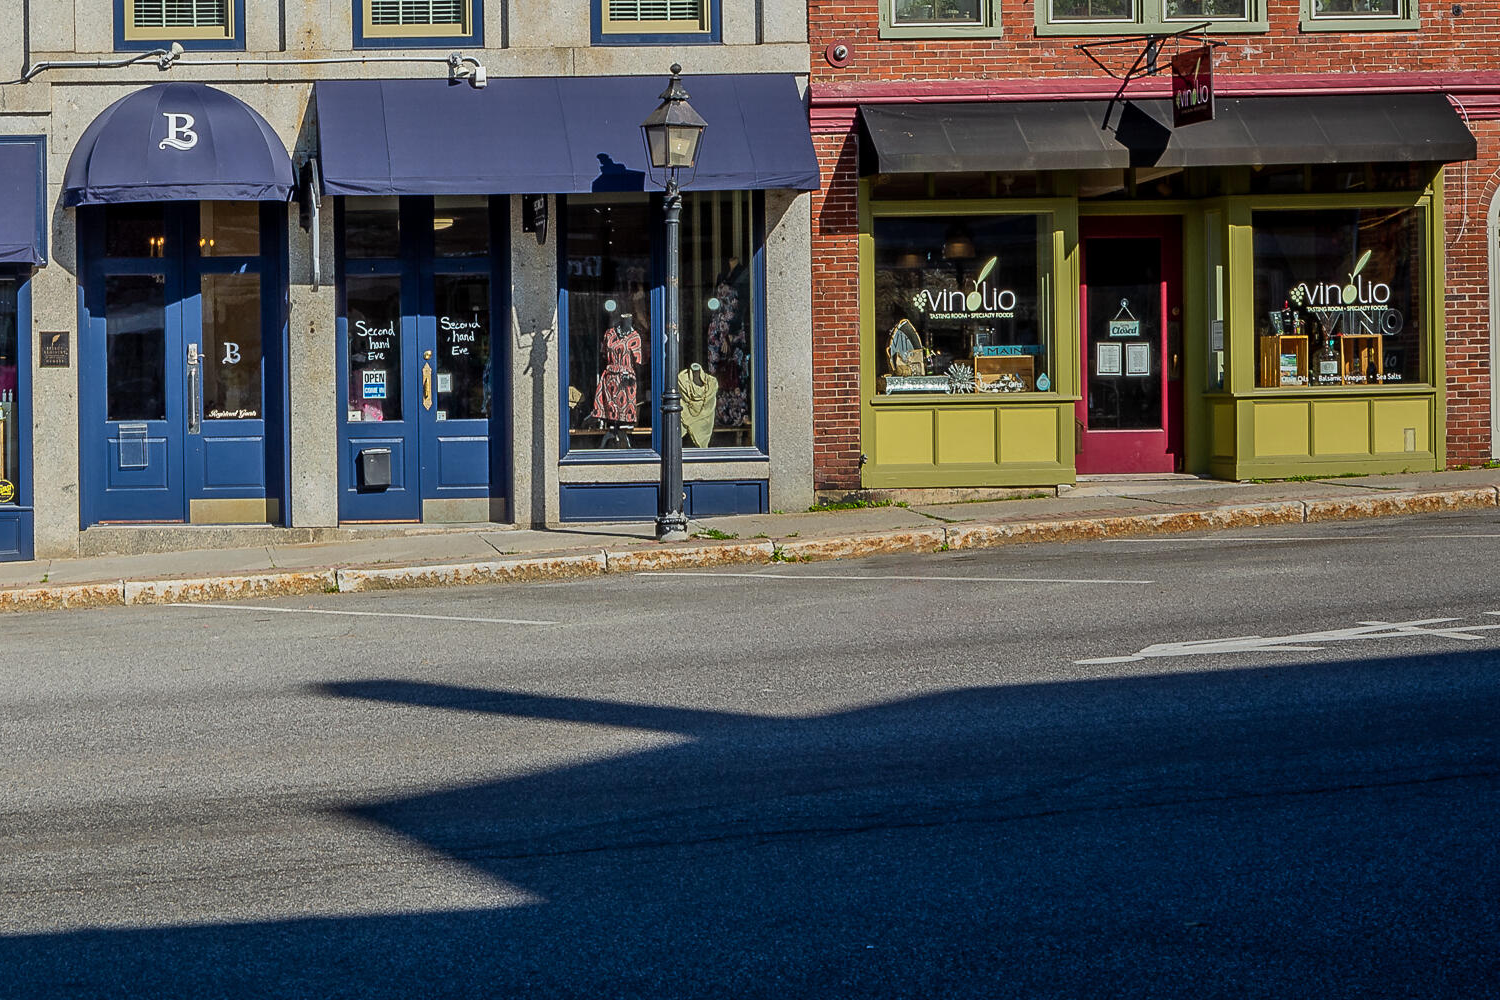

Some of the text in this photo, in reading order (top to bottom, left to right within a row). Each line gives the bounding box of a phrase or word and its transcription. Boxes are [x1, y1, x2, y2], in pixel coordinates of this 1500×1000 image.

[158, 112, 198, 150] B
[920, 281, 1016, 312] vinolio
[1298, 274, 1391, 305] vinolio
[355, 320, 396, 337] Second
[440, 313, 481, 330] Second
[452, 330, 475, 343] hand
[1111, 326, 1138, 335] Closed
[368, 336, 391, 350] hand
[222, 342, 241, 365] B
[367, 351, 386, 361] Eve
[451, 345, 470, 356] Eve
[364, 373, 385, 383] OPEN
[1298, 375, 1309, 383] Oils
[1318, 374, 1342, 382] Balsamic
[1344, 374, 1367, 383] Vinegars
[1376, 373, 1386, 381] Sea
[1387, 373, 1402, 381] Salts
